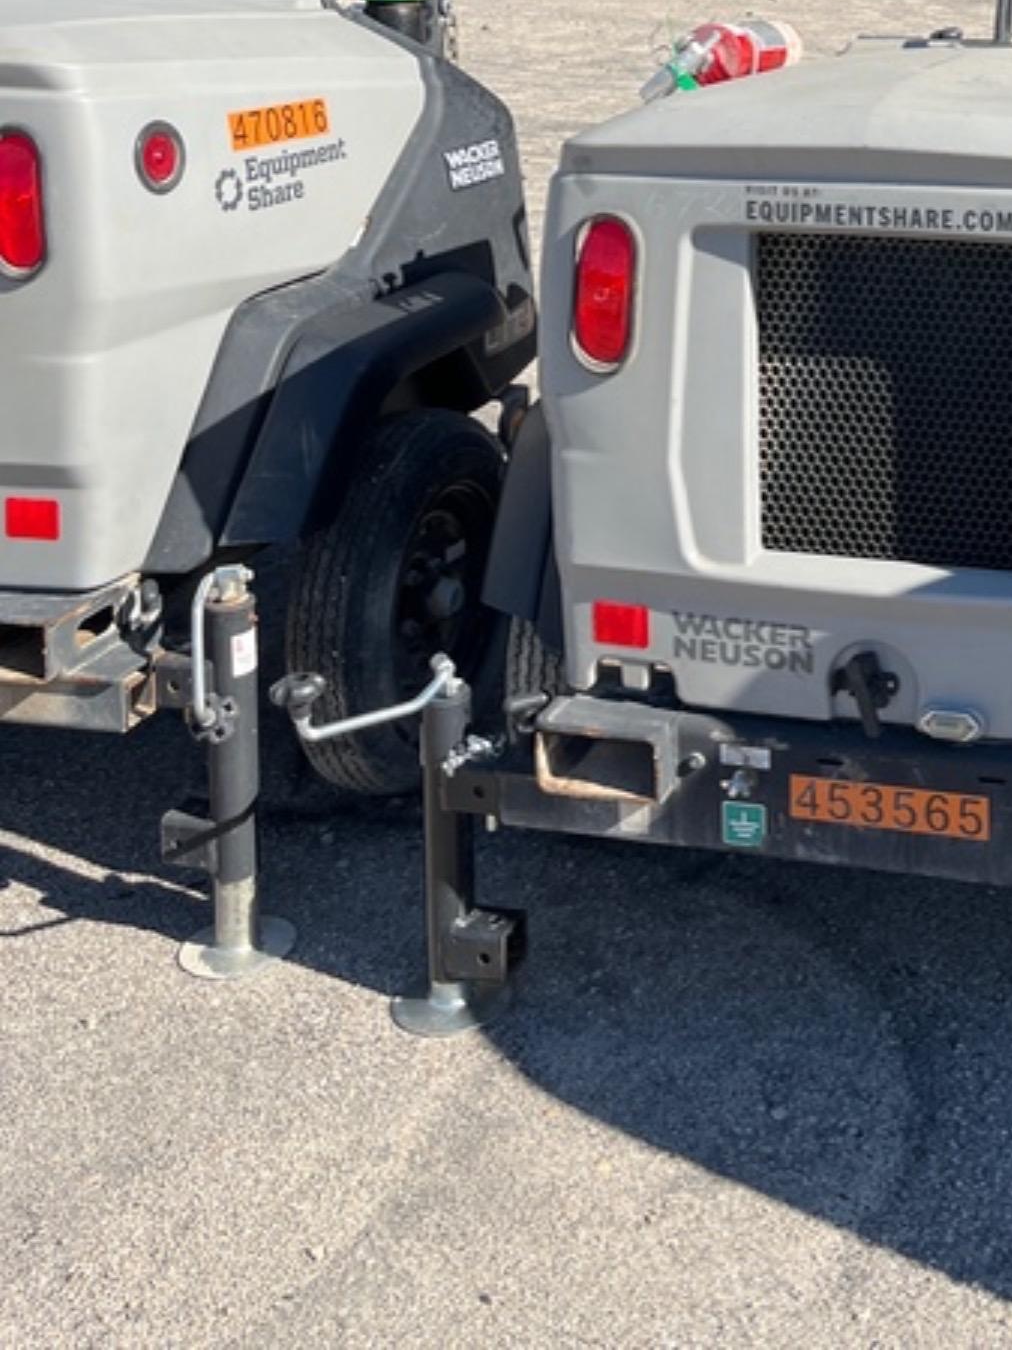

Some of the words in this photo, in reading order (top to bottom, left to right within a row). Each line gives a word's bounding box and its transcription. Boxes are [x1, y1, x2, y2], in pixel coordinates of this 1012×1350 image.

[232, 99, 328, 144] 470816
[245, 137, 346, 183] Equipment
[247, 179, 304, 211] Share
[671, 610, 814, 649] WACKER
[673, 635, 815, 674] NEUSON
[796, 780, 983, 835] 453565
